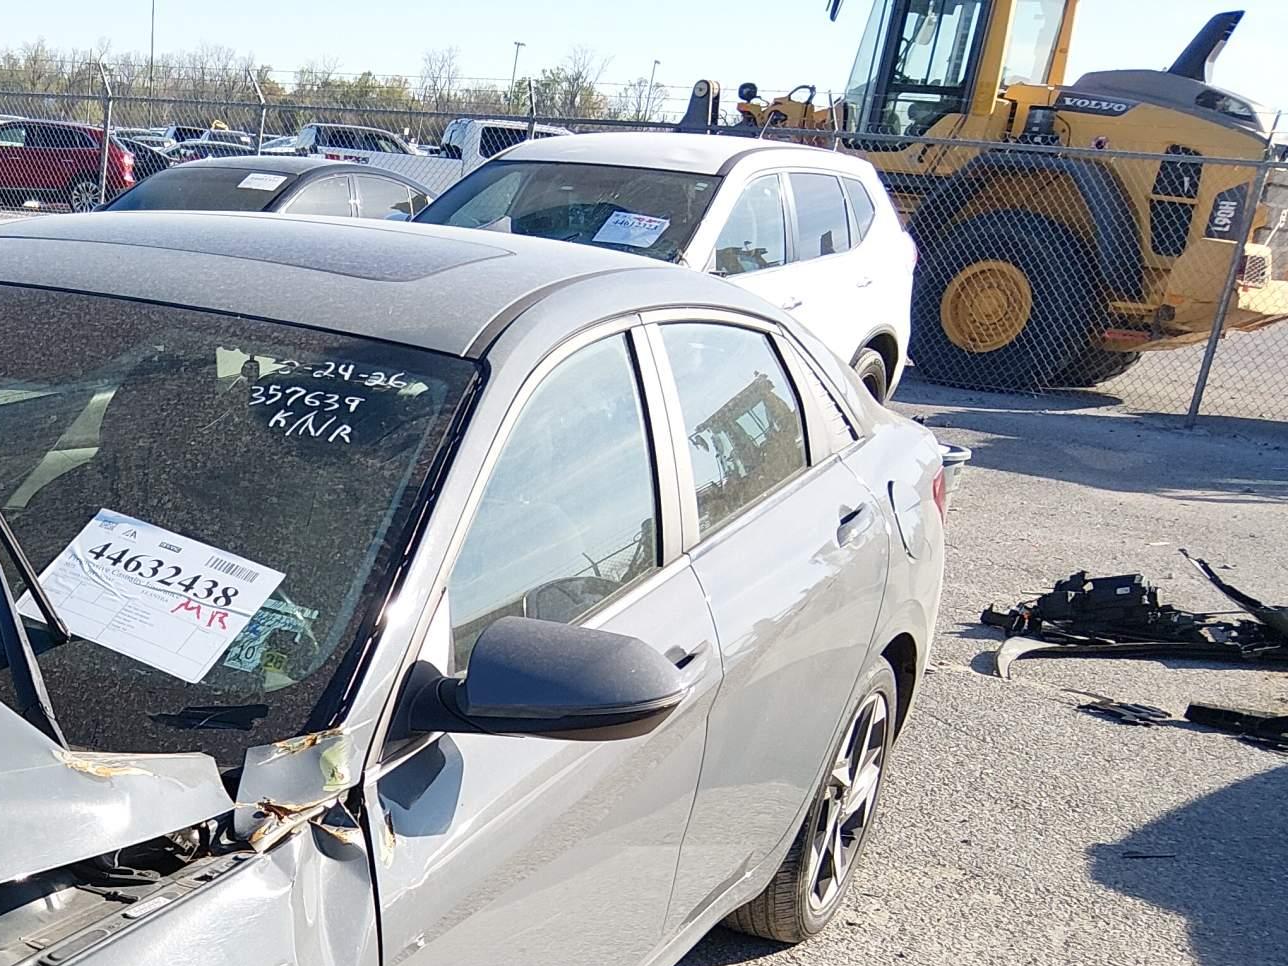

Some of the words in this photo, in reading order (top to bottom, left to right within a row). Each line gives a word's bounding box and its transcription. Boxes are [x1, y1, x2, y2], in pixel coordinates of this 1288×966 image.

[1063, 97, 1127, 112] VOLVO
[1213, 201, 1237, 232] L90H
[249, 385, 366, 413] 357639
[88, 542, 239, 607] 44632438
